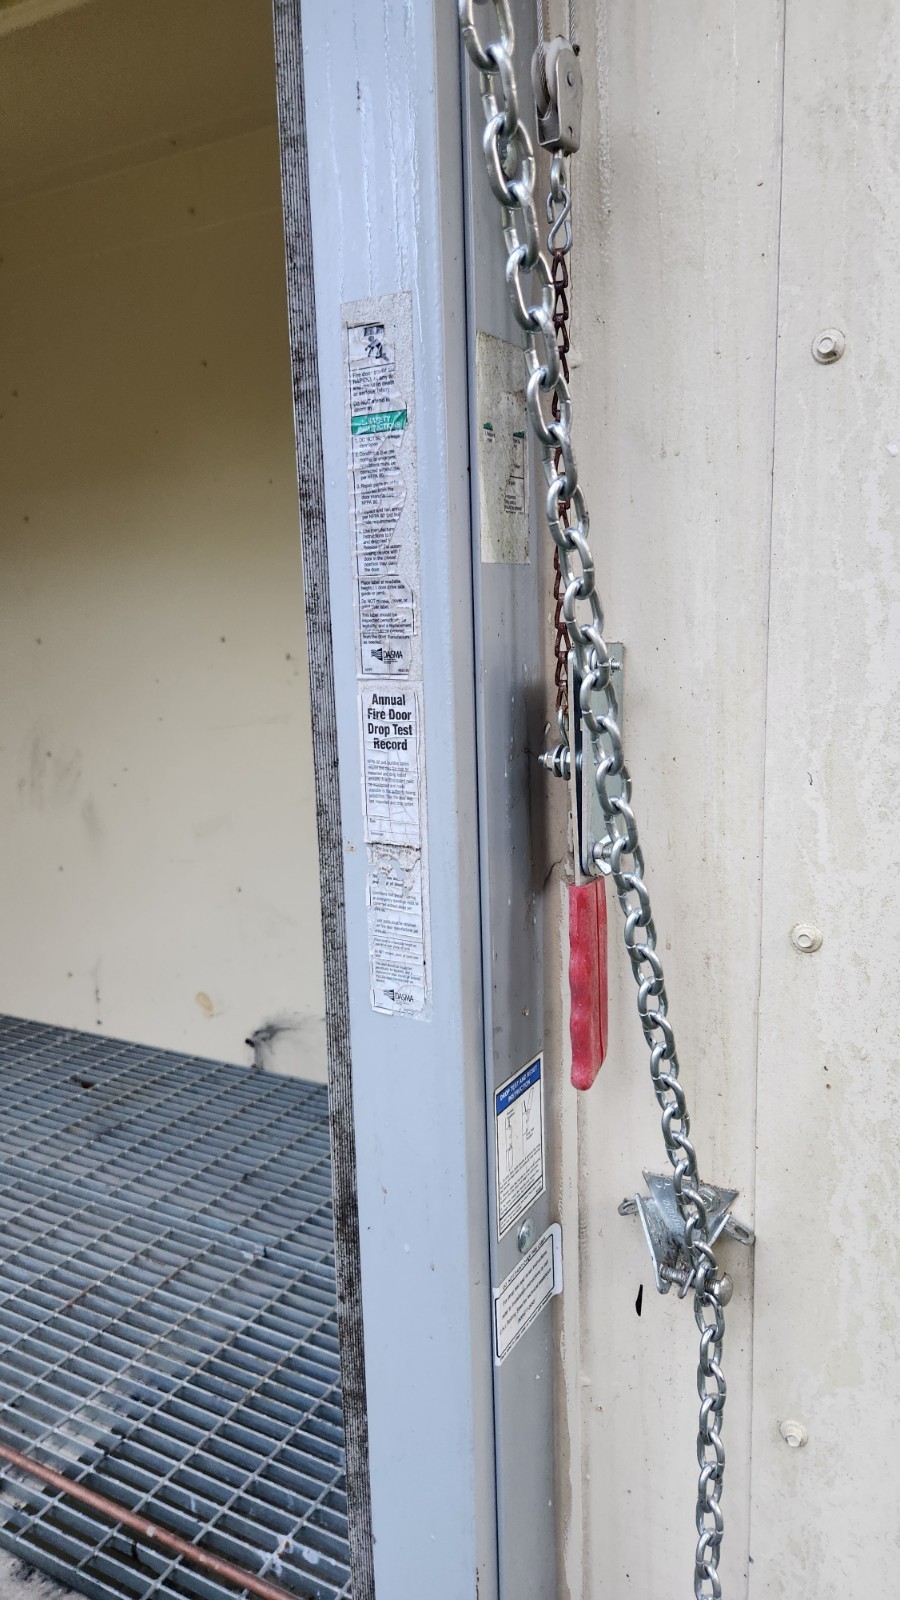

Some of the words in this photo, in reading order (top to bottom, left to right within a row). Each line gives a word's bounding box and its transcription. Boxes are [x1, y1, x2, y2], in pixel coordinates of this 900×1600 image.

[384, 650, 403, 659] DASMA
[372, 693, 406, 706] Annual
[367, 708, 386, 720] Fire
[389, 709, 412, 720] Door
[368, 723, 390, 737] Drop
[393, 724, 413, 736] Test
[373, 739, 408, 750] Record
[395, 993, 413, 1002] DASMA
